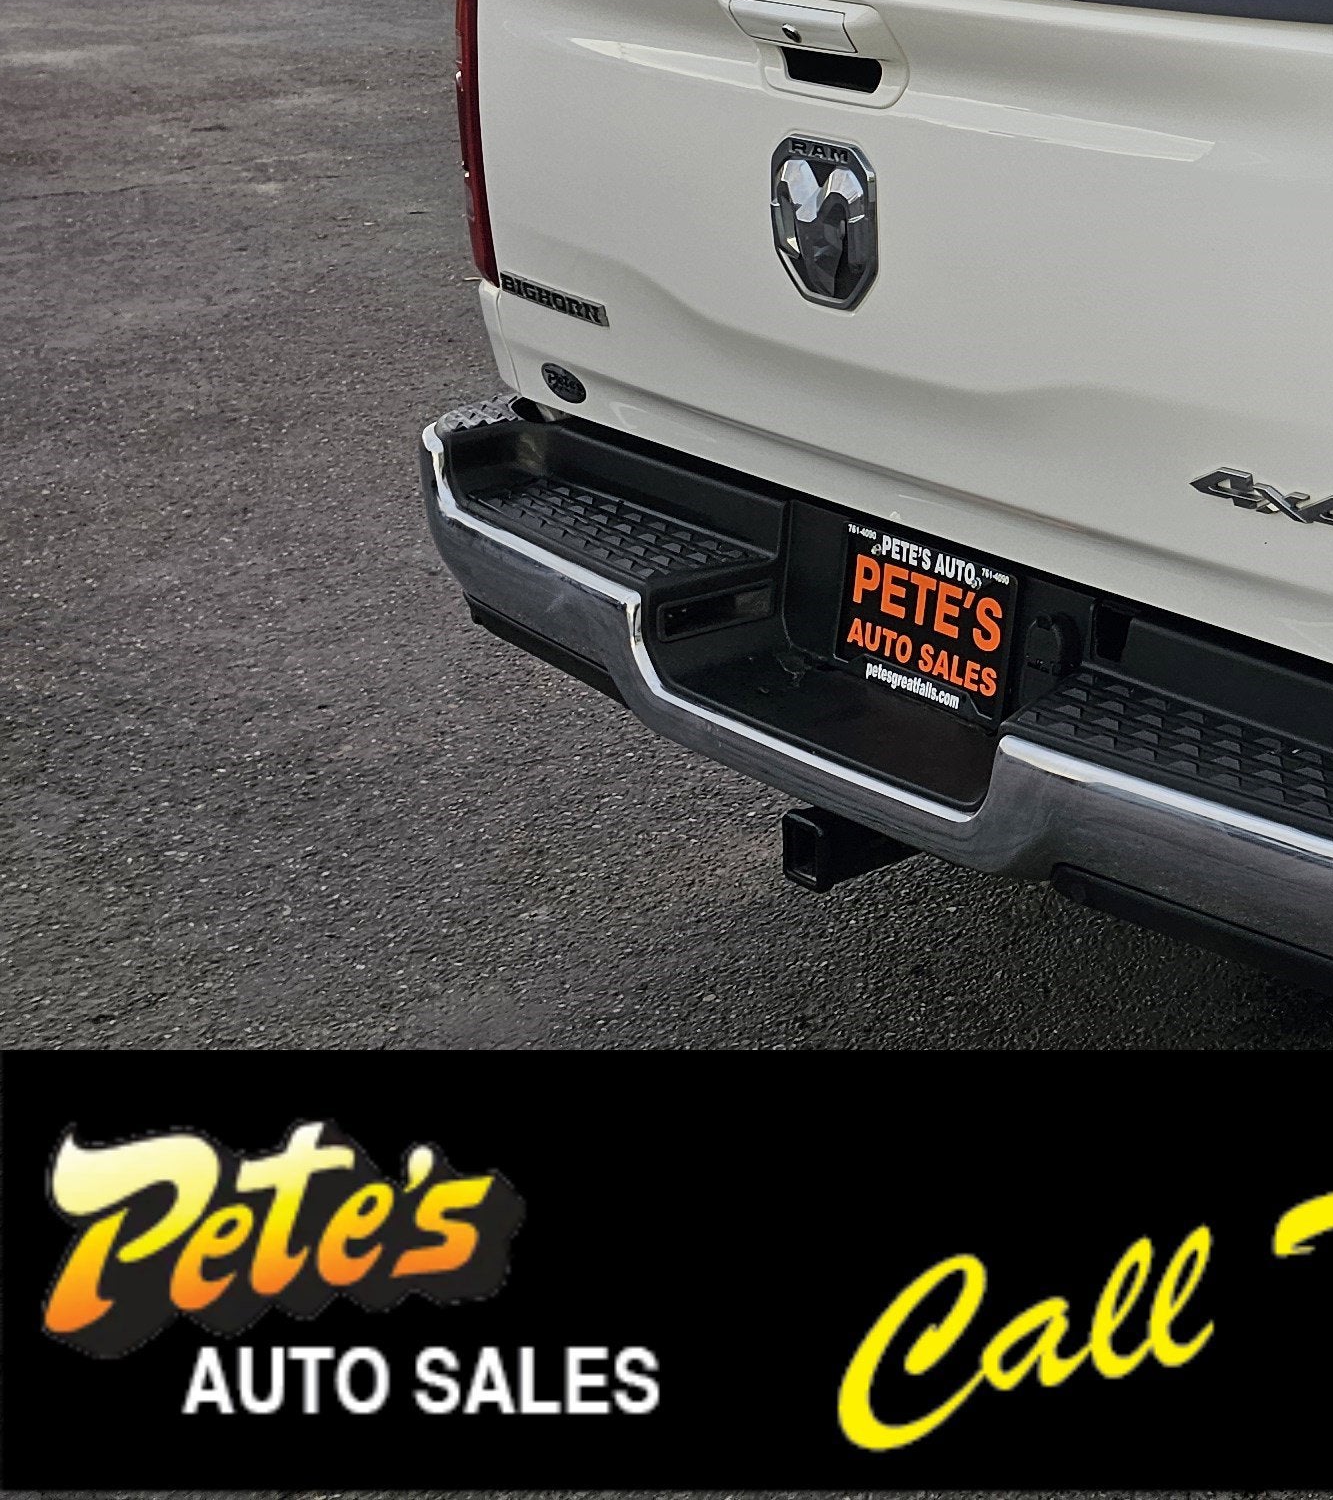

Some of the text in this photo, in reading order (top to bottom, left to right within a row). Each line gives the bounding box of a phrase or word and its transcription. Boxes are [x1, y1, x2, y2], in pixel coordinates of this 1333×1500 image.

[788, 140, 849, 164] RAM
[848, 523, 877, 541] 761-4090
[881, 534, 976, 585] PETE'S AUTO
[981, 567, 1011, 586] 761-4090
[853, 553, 1003, 652] PETE'S
[846, 617, 998, 698] AUTO SALES
[865, 662, 960, 710] petesgreatfalls.com
